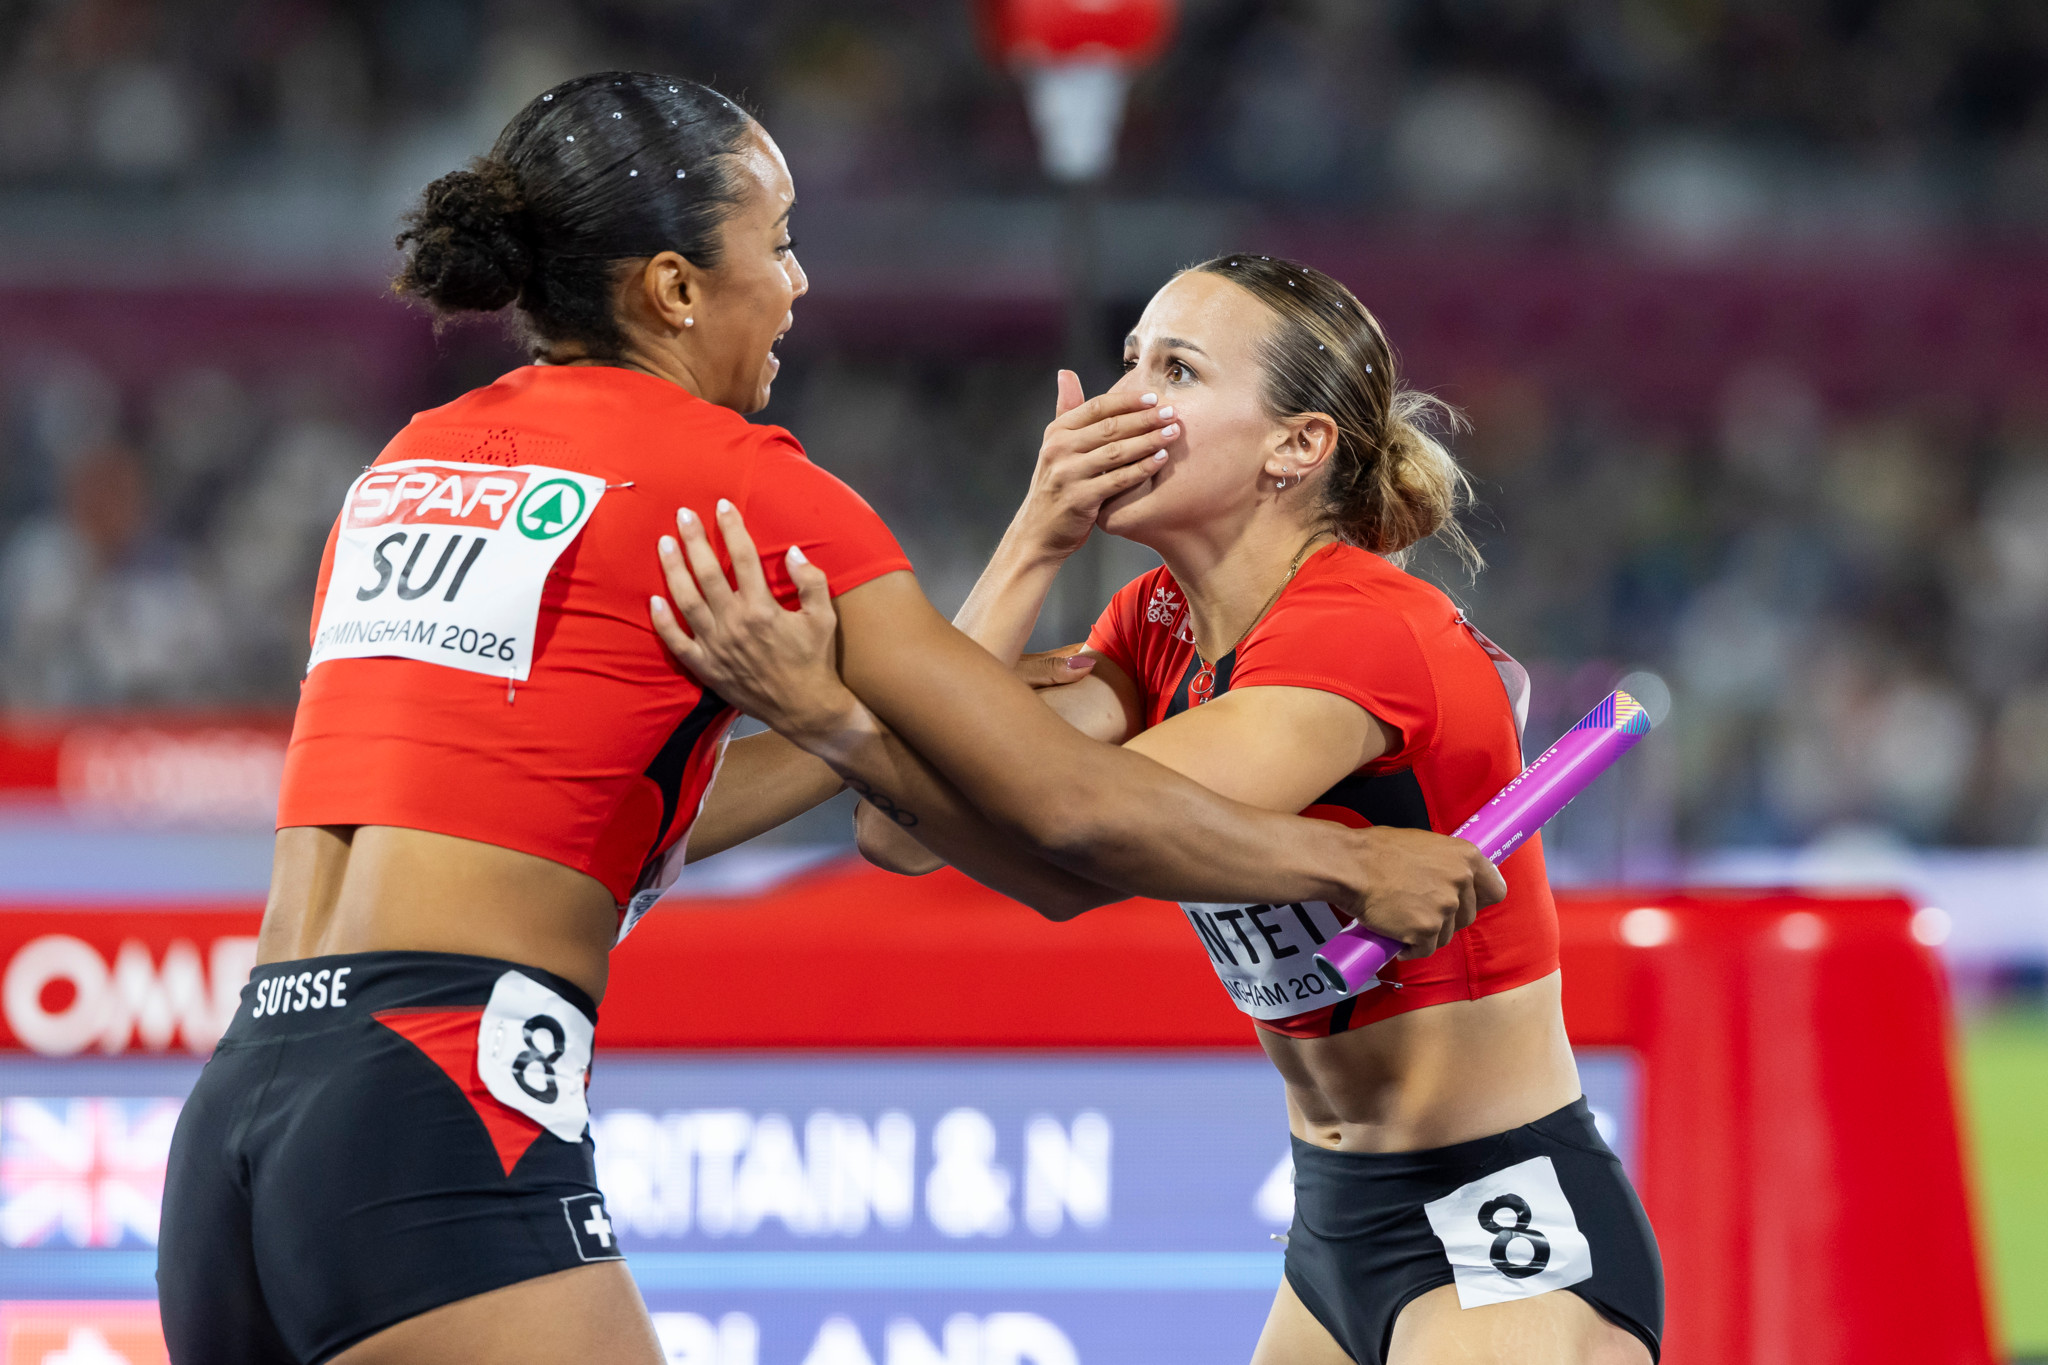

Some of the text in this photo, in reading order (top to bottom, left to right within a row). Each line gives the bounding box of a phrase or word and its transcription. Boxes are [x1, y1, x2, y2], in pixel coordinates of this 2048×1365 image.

[353, 473, 518, 521] SPAR
[356, 532, 487, 602] SUI
[440, 625, 516, 662] 2026
[1501, 830, 1523, 851] Nordic
[512, 1014, 566, 1104] 8
[925, 1107, 1015, 1238] &
[1478, 1193, 1551, 1279] 8
